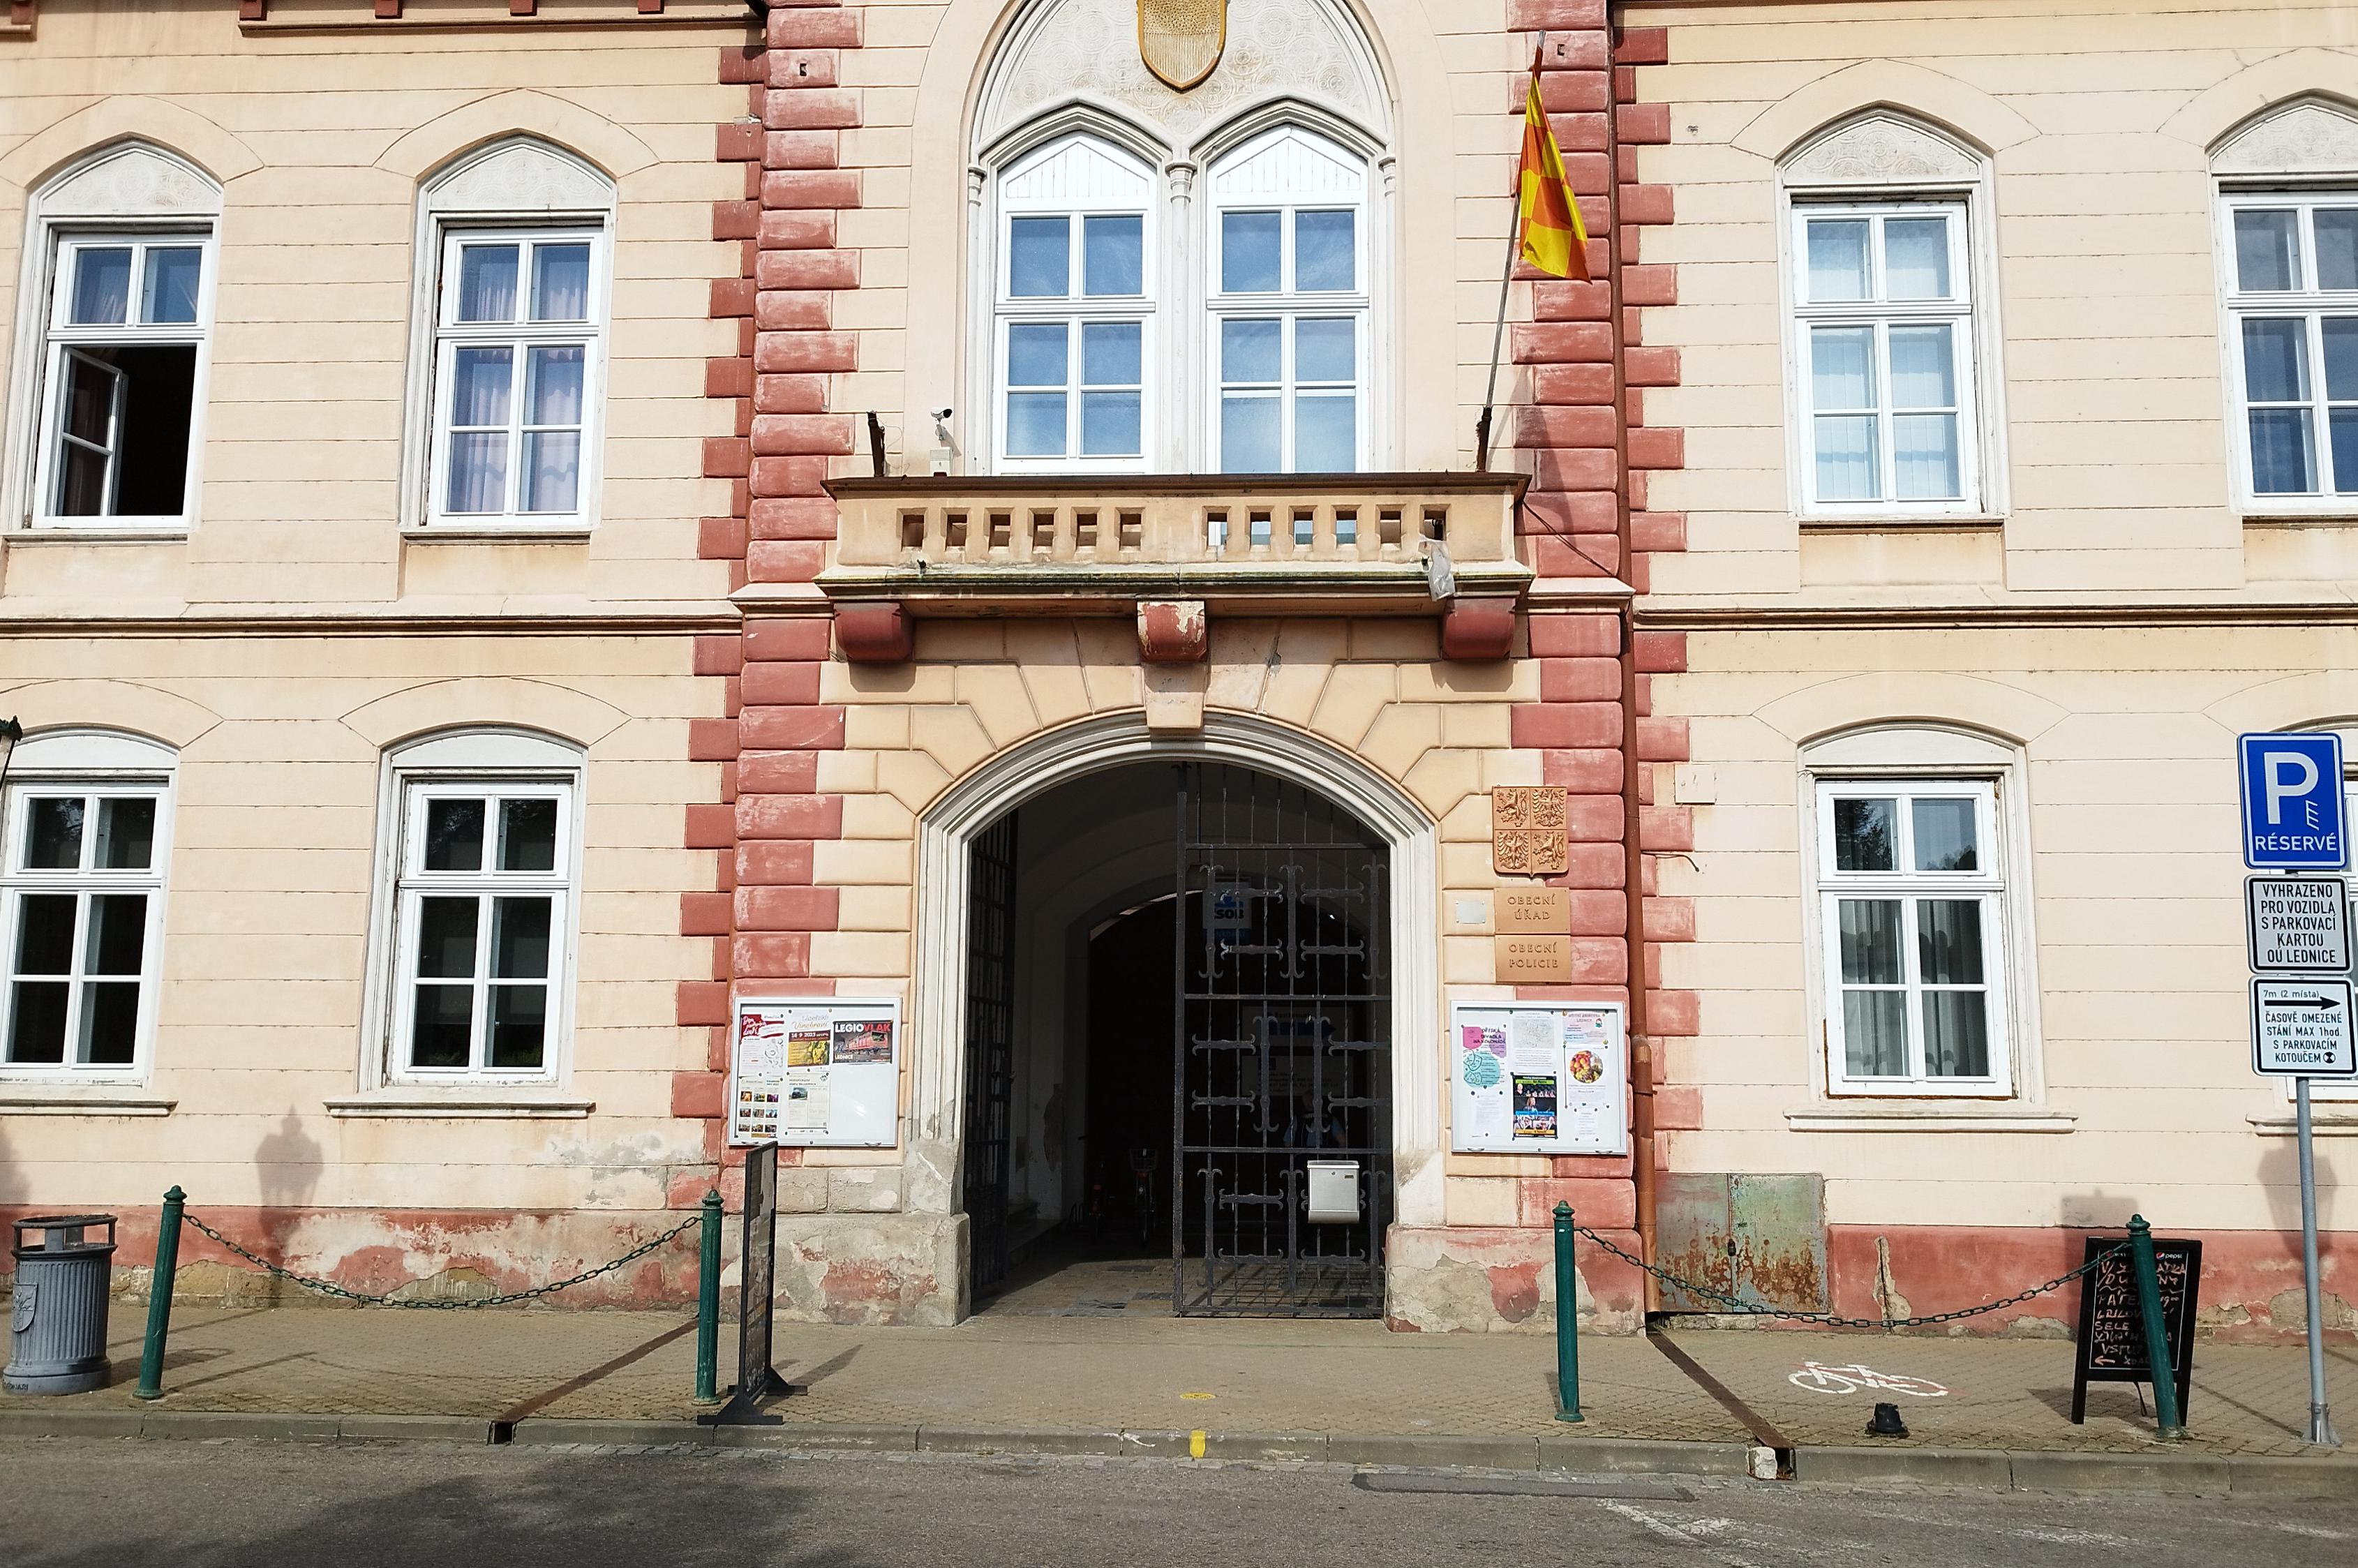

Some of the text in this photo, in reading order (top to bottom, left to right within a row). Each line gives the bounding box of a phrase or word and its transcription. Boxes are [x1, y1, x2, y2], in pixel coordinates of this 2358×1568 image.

[2264, 752, 2319, 824] P
[2255, 832, 2337, 851] RÉSERVÉ
[2262, 883, 2333, 898] VYHRAZENO
[1507, 893, 1555, 905] OBECNÍ
[2261, 900, 2336, 914] PRO VOZIDLA
[1514, 909, 1550, 920] ÚŘAD
[2261, 913, 2336, 930] S PARKOVACÍ
[2277, 933, 2324, 946] KARTOU
[1509, 941, 1557, 953] OBECNÍ
[2267, 946, 2336, 963] OÚ LEDNICE
[1509, 959, 1558, 969] POLICIE
[2263, 990, 2320, 998] 7m (2 místa)
[2265, 1010, 2342, 1024] ČASOVĚ OMEZENÉ
[2267, 1024, 2343, 1037] STÁNÍ MAX 1hod.
[2273, 1038, 2337, 1050] S PARKOVACÍM
[2275, 1051, 2321, 1063] KOTOUČEM
